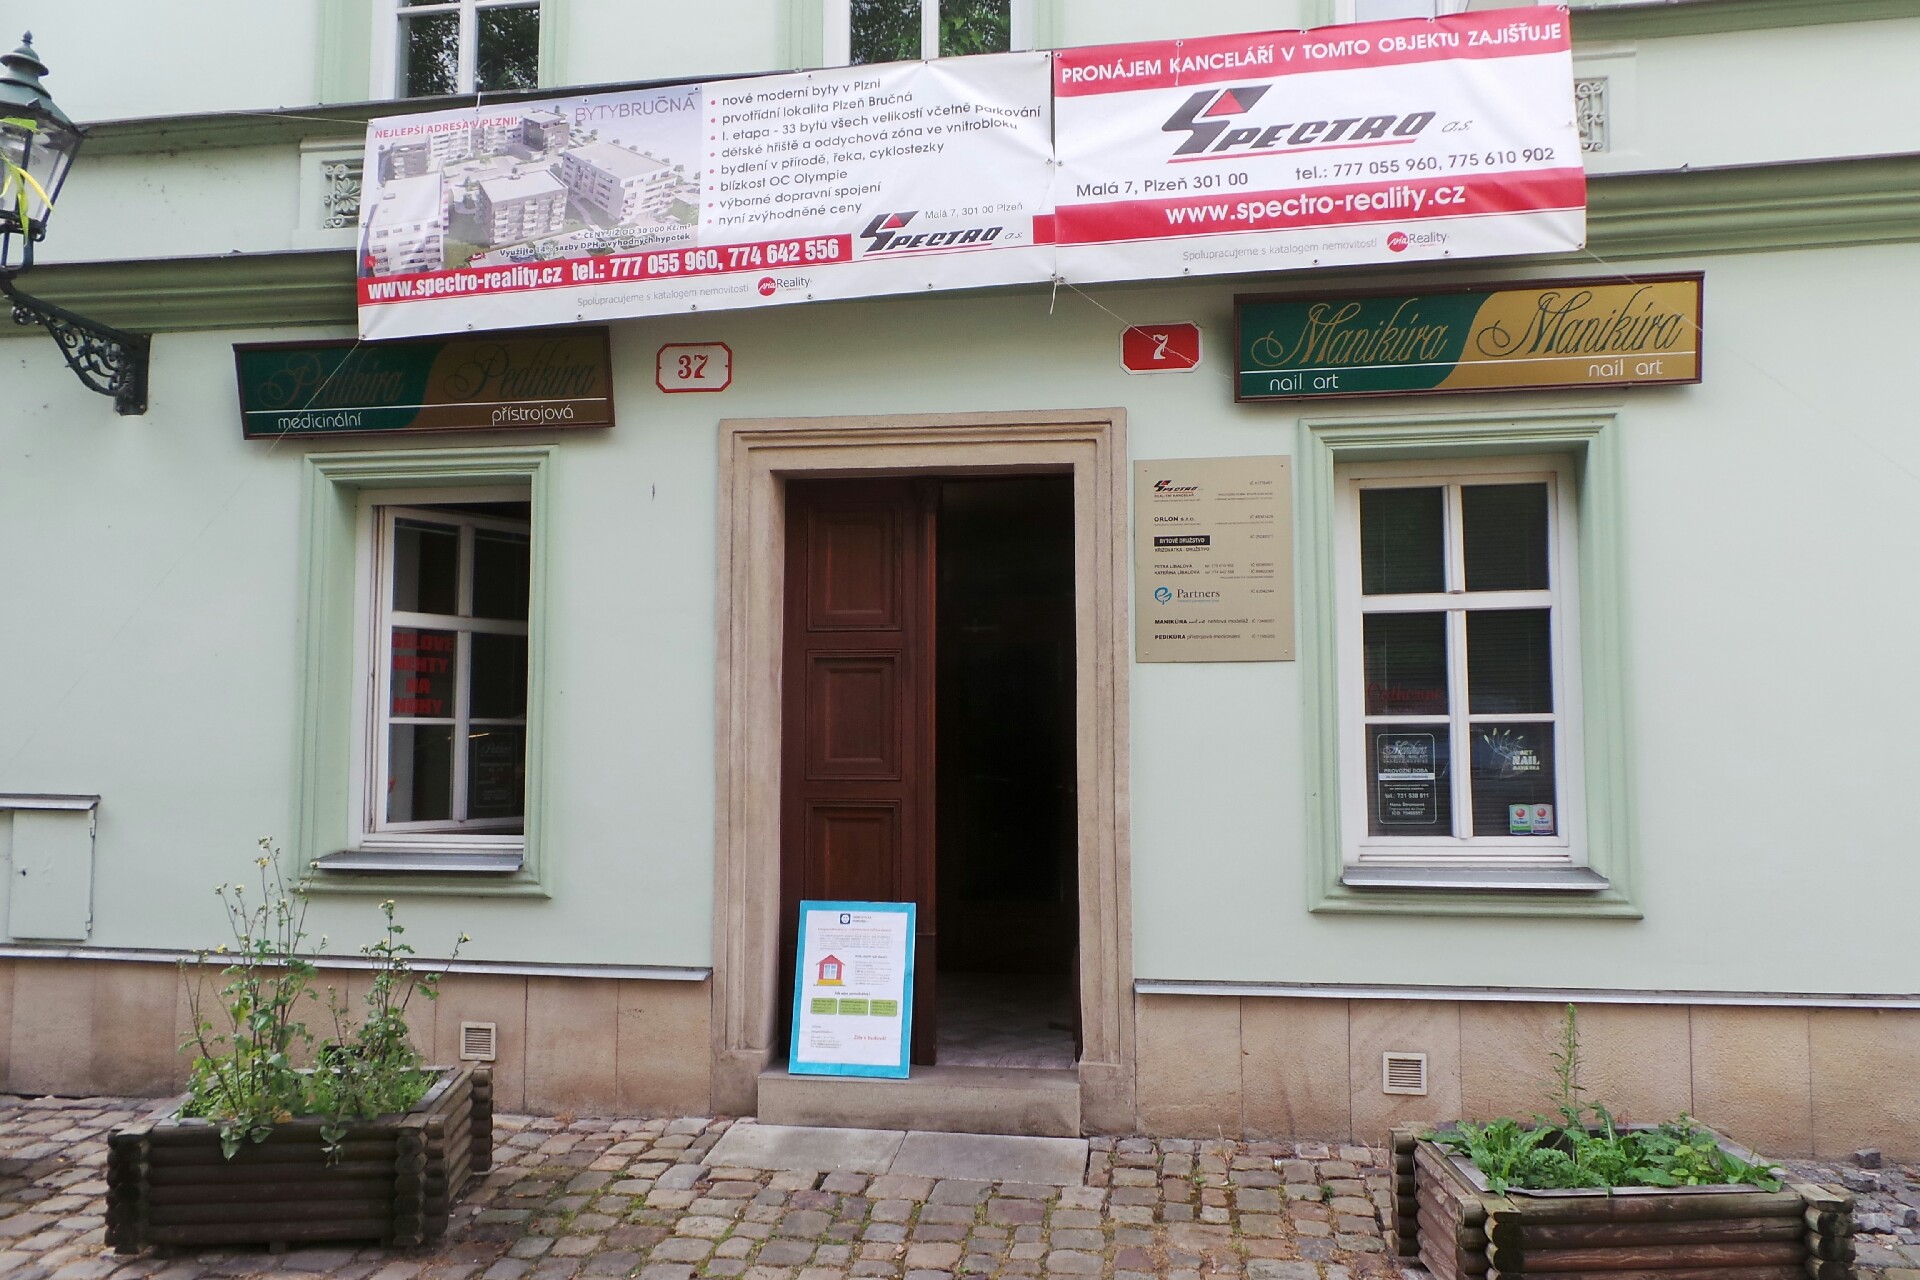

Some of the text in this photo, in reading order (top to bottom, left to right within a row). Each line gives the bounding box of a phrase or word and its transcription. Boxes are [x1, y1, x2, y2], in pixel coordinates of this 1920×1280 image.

[1062, 23, 1561, 83] PRONÁJEM KANCELÁŘÍ V TOMTO OBJEKTU ZAJIŠŤUJE
[722, 93, 753, 105] nové
[758, 87, 808, 102] moderní
[812, 84, 839, 96] byty
[855, 79, 880, 91] Plzni
[723, 92, 912, 125] prvotřídní lokalita Plzeň Bručná
[733, 128, 769, 140] etapa
[783, 124, 795, 135] 33
[832, 115, 868, 129] všech
[873, 108, 923, 123] velikostí
[927, 102, 970, 116] včetně
[975, 105, 1041, 118] parkování
[1162, 84, 1473, 155] SPECTRO a.s.
[375, 117, 517, 138] NEJLEPŠÍ ADRESA V PLZNI!
[722, 146, 762, 157] dětské
[767, 141, 798, 153] hřiště
[815, 130, 887, 147] oddychová
[892, 127, 922, 138] zóna
[927, 126, 941, 134] ve
[946, 118, 1017, 133] vnitrobloku
[722, 160, 768, 175] bydlení
[782, 156, 829, 170] přírodě,
[833, 152, 865, 163] řeka,
[870, 143, 944, 159] cyklostezky
[1296, 148, 1554, 181] tel.: 777 055 960, 775 610 902
[721, 170, 847, 191] blízkost OC Olympie
[1077, 172, 1248, 197] Malá 7, Plzeň 301 00
[720, 181, 881, 210] výborné dopravní spojení
[1166, 185, 1465, 224] www.spectro-reality.cz
[719, 202, 862, 226] nyní zvýhodněné ceny
[926, 202, 1022, 219] Malá 7, 301 00 Plzeň
[860, 211, 1022, 252] SPECTRO a.s.
[1409, 232, 1447, 244] Reality
[500, 248, 533, 257] Využijte
[1183, 247, 1258, 261] Spolupracujeme
[1269, 242, 1319, 255] katalogem
[368, 239, 838, 299] www.spectro-reality.cz tel.: 777 055 960, 774 642 556
[777, 277, 810, 288] Reality
[578, 292, 644, 308] Spolupracujeme
[653, 289, 696, 301] katalogem
[1252, 298, 1448, 367] Manikúra
[1477, 286, 1684, 356] Manikúra
[1152, 335, 1170, 361] 7
[678, 354, 709, 380] 37
[1588, 359, 1664, 377] nail art
[1270, 373, 1338, 391] nail art
[278, 411, 361, 429] medicinální
[492, 404, 574, 425] přístrojová
[1177, 589, 1220, 598] Partners
[1513, 756, 1540, 765] NAIL
